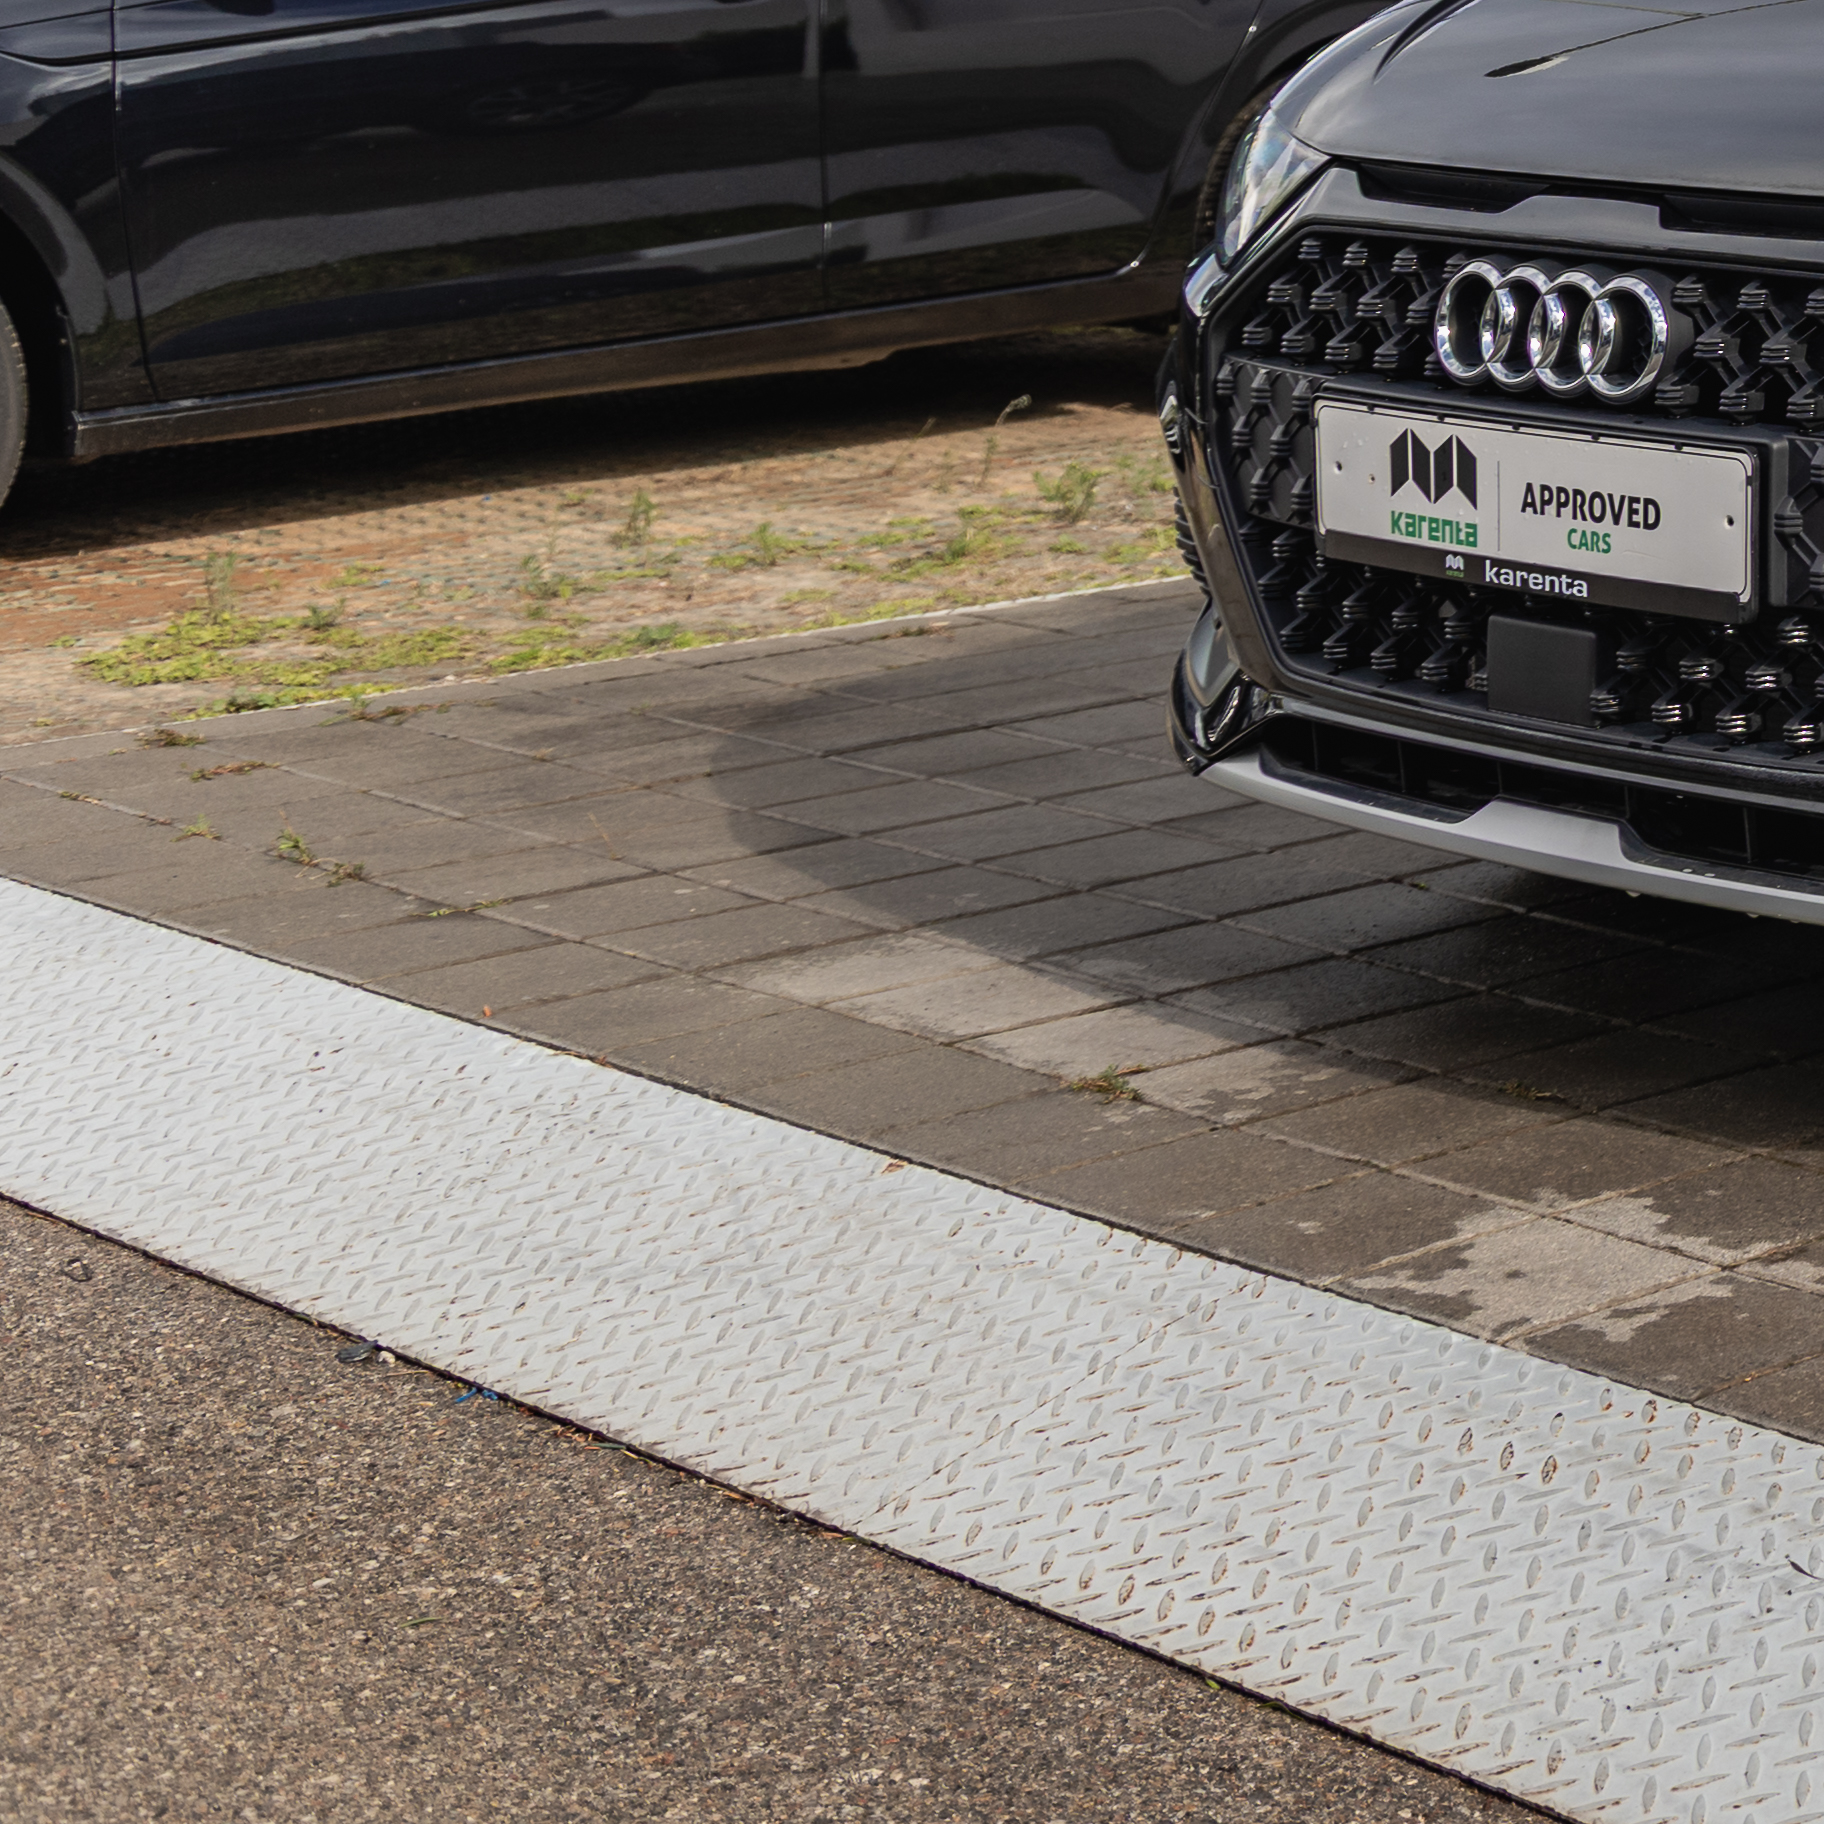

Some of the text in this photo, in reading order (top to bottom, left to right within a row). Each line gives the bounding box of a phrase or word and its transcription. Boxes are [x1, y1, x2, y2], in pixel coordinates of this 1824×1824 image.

[1520, 482, 1661, 531] APPROVED
[1567, 528, 1612, 555] CARS
[1485, 559, 1588, 598] karenta
